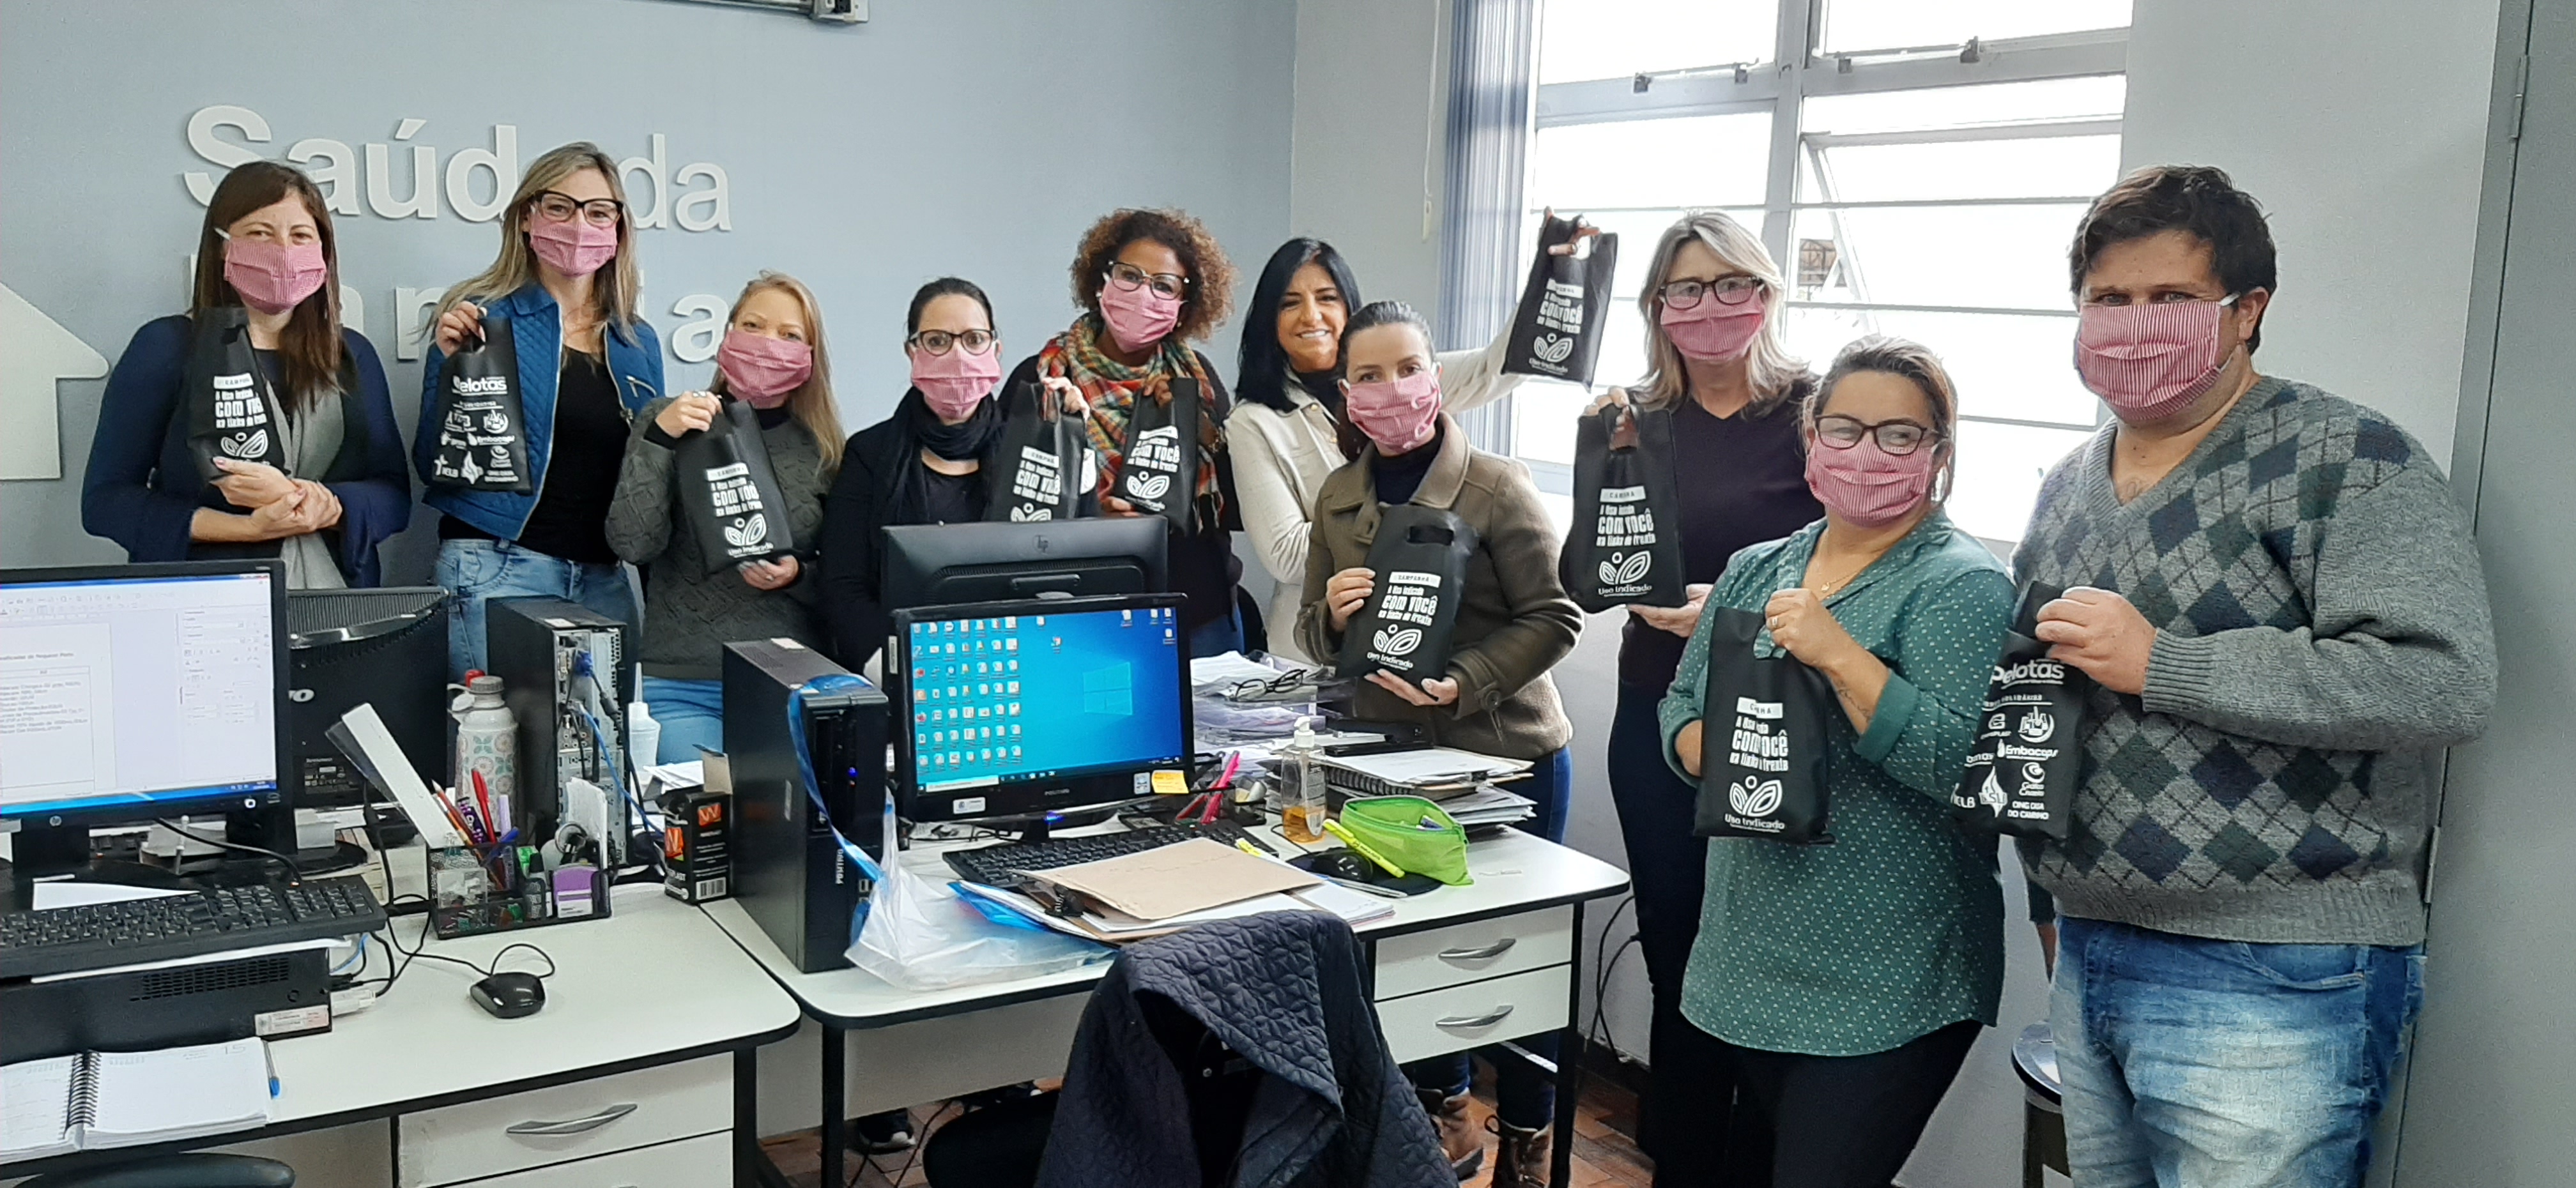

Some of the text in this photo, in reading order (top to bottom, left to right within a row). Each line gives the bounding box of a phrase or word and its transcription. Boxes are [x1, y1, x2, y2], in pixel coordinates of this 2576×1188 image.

[183, 105, 732, 232] Saúd da
[215, 400, 244, 418] COM
[1598, 507, 1654, 535] COM VOCÊ
[1381, 594, 1439, 616] COM VOCÊ
[1989, 659, 2064, 685] Pelotas
[1761, 729, 1789, 758] OCÊ
[1742, 818, 1785, 830] Indicado
